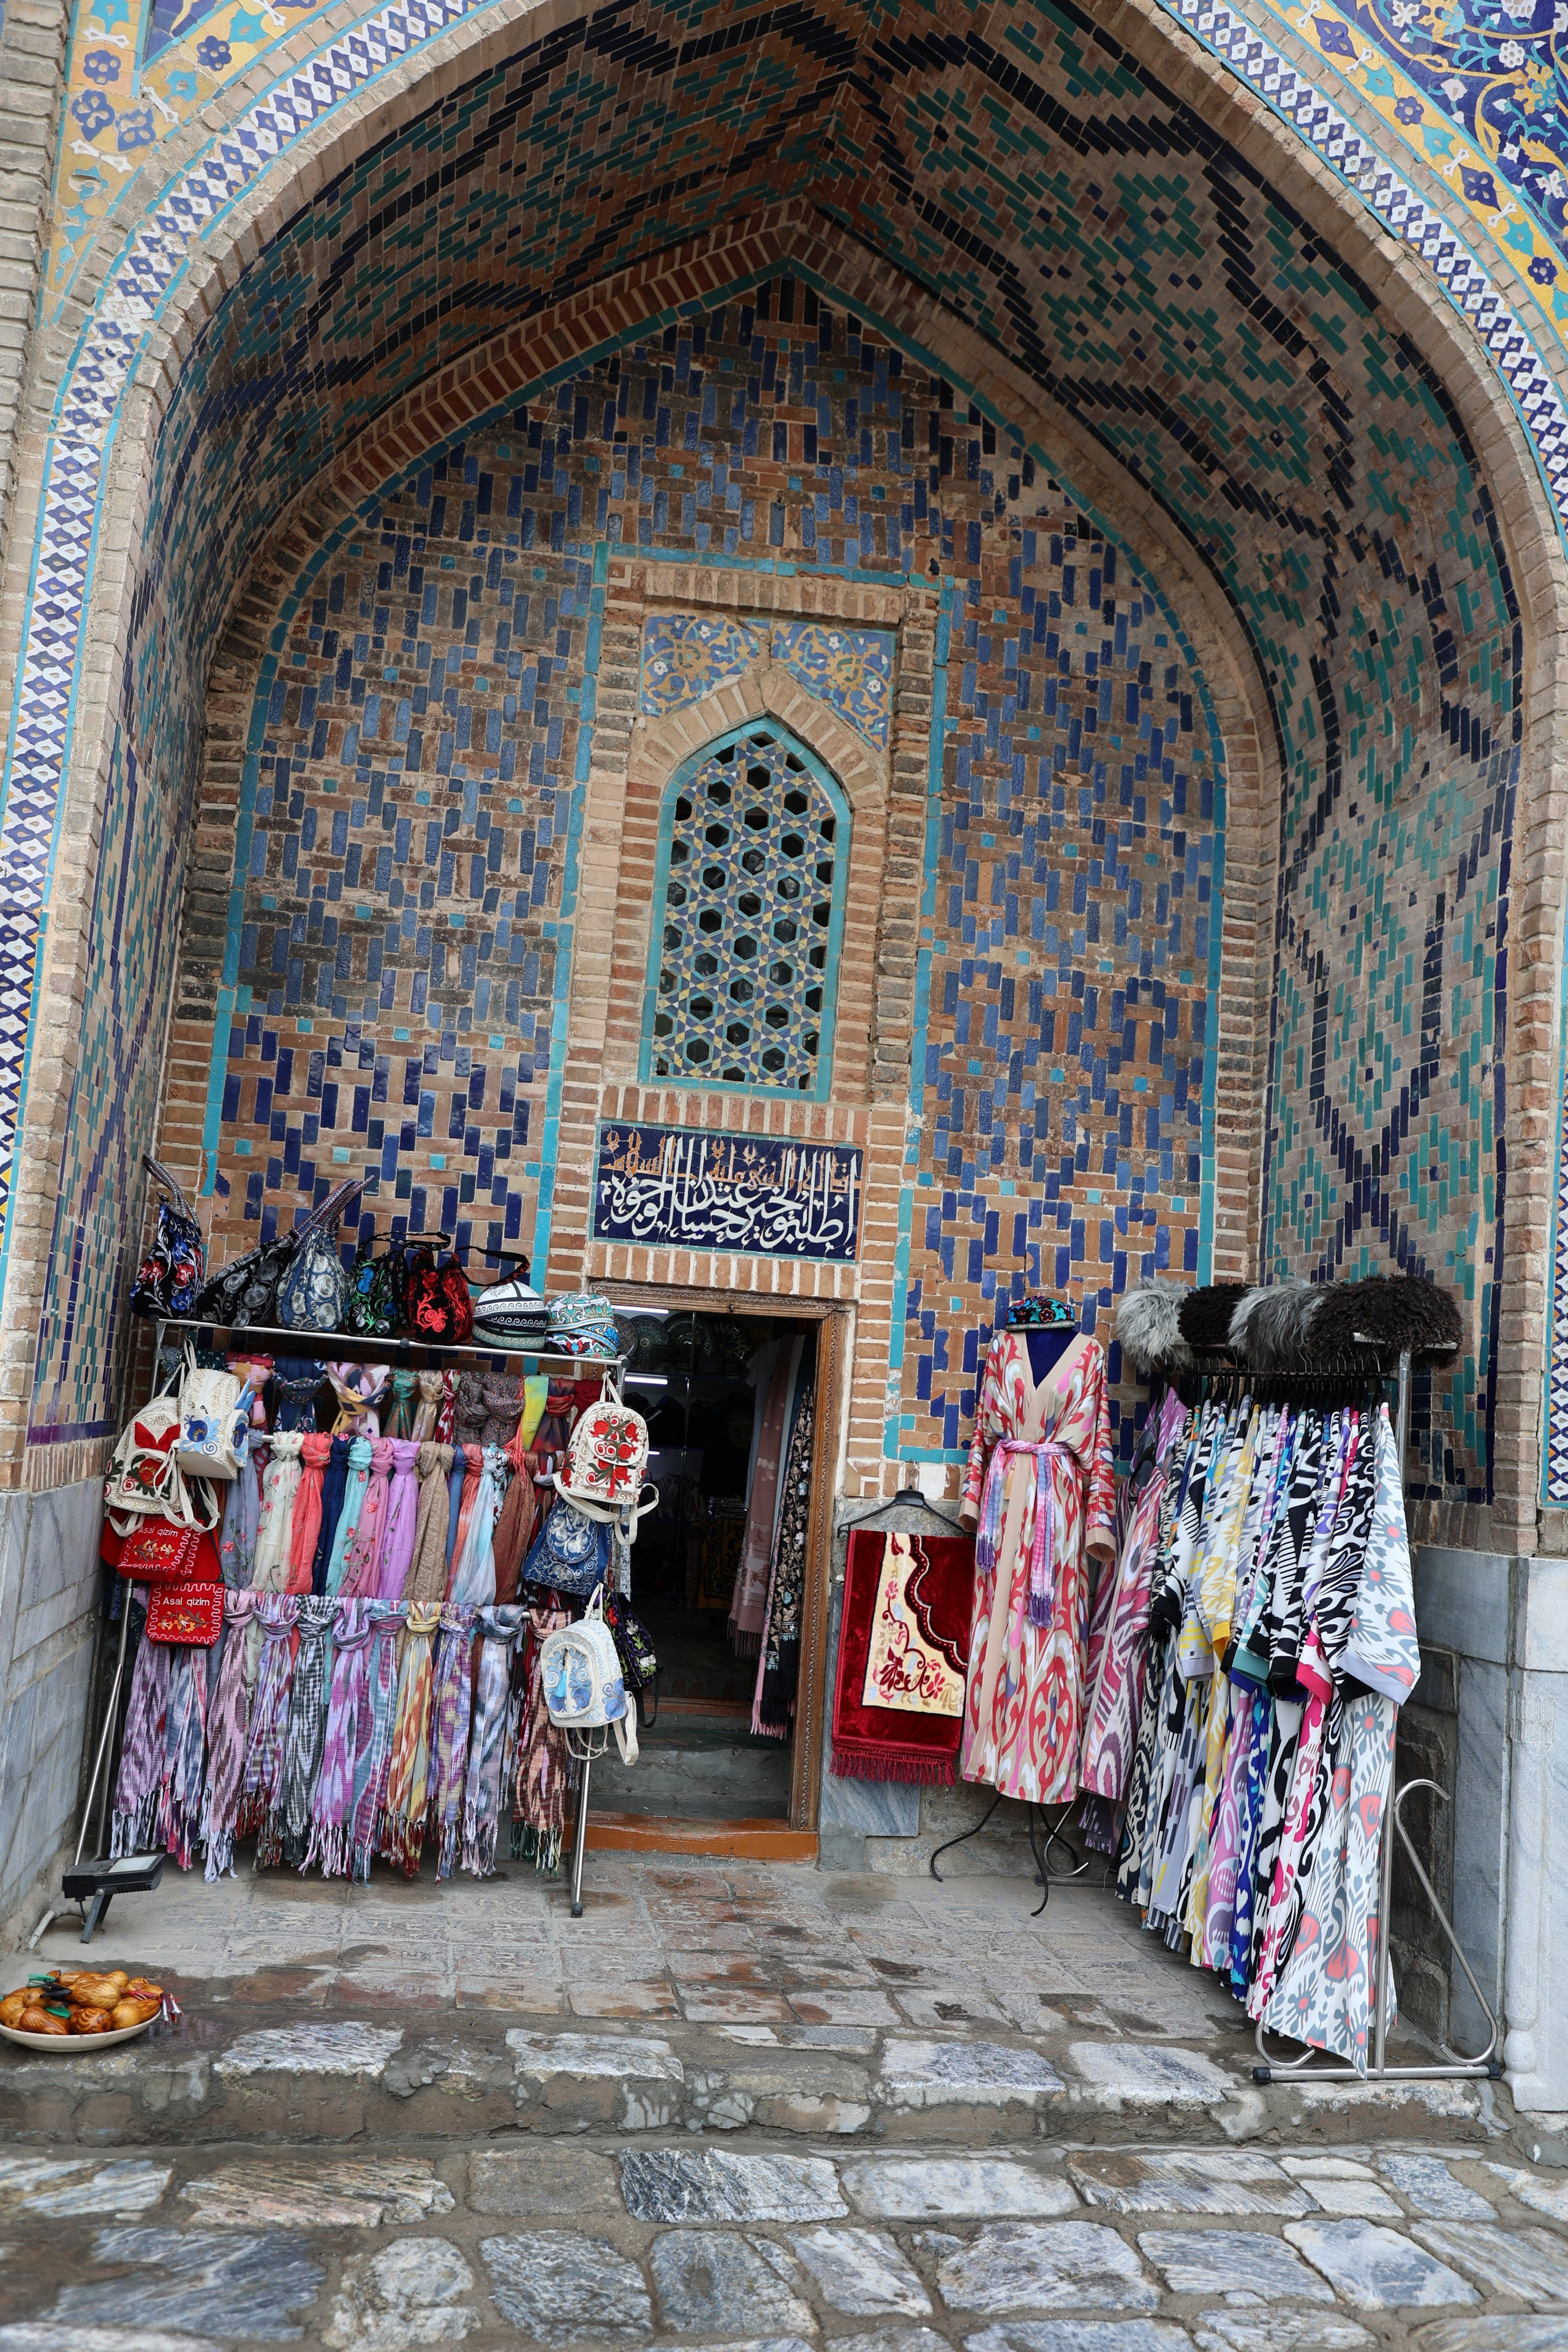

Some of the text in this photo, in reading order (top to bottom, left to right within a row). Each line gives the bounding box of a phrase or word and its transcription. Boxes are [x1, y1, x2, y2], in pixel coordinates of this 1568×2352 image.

[157, 1528, 178, 1537] qizim
[162, 1597, 210, 1608] Asal qizim
